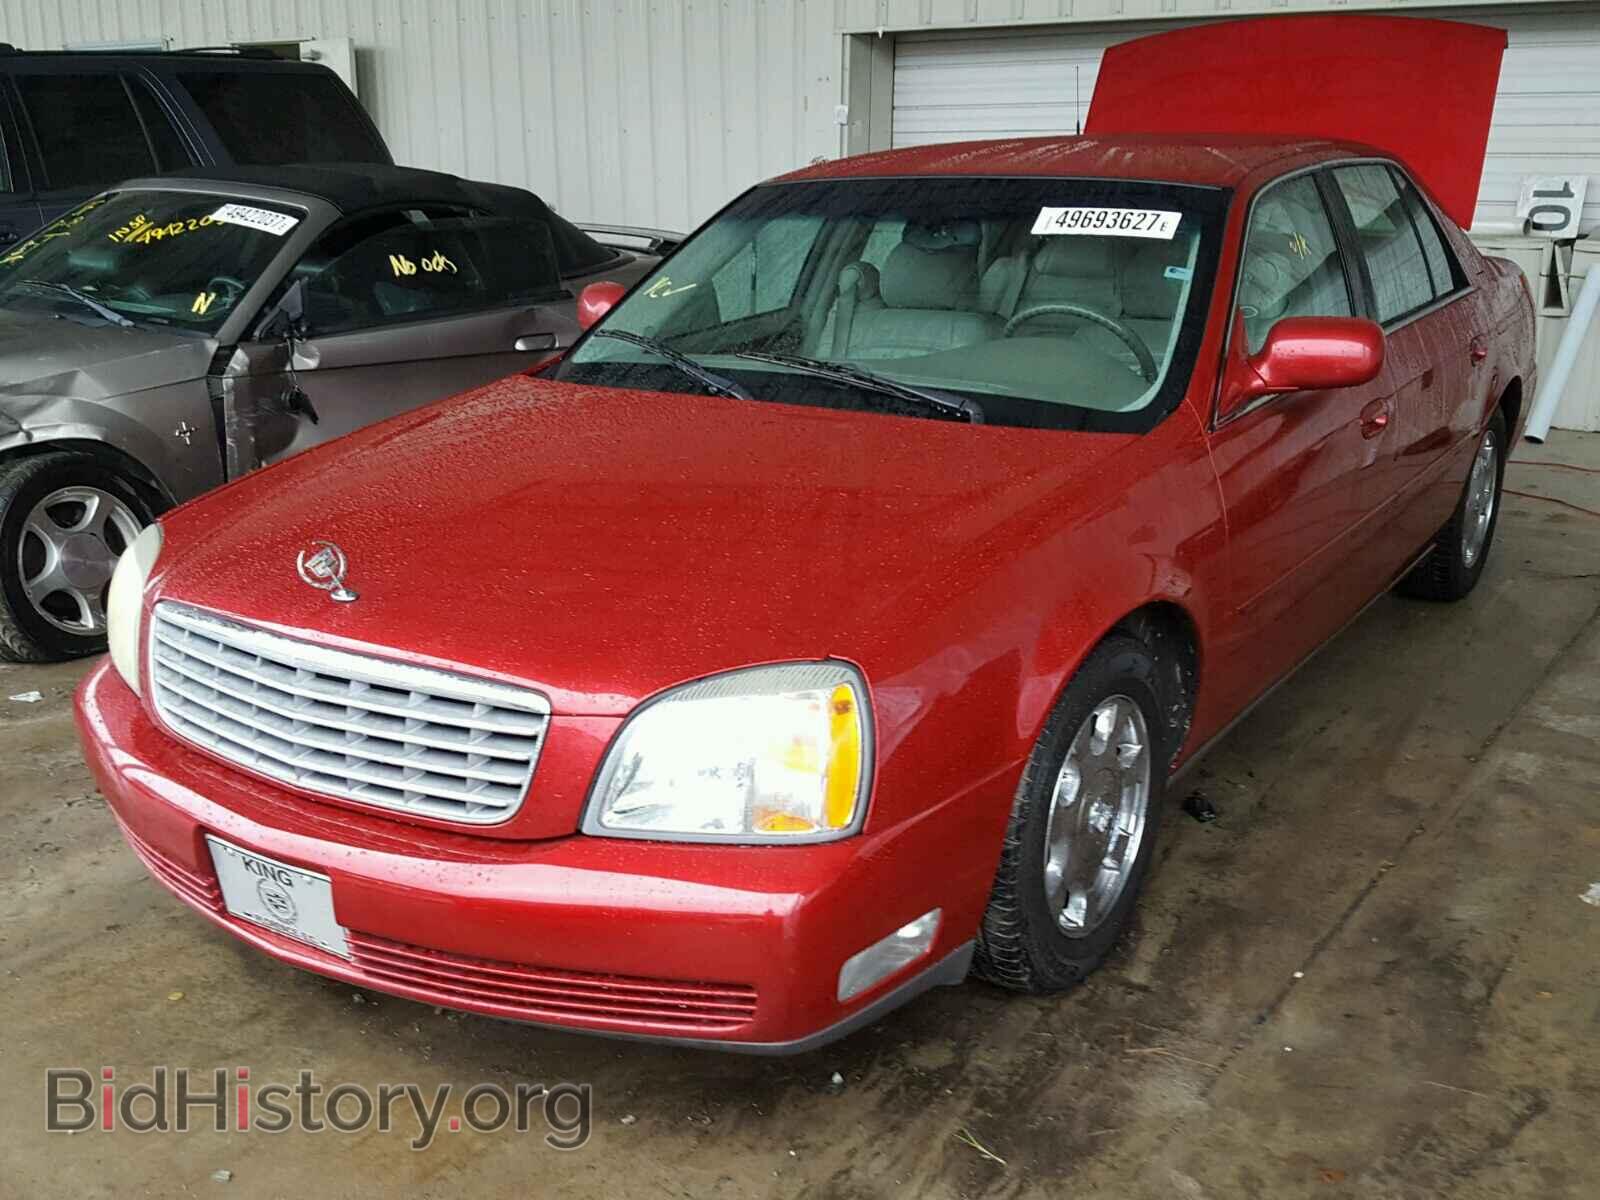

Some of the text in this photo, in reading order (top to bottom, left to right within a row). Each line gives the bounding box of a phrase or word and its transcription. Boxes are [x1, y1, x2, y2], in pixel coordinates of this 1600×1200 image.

[1528, 181, 1575, 231] 10
[1055, 209, 1161, 232] 49693627
[191, 292, 215, 315] N
[241, 855, 294, 887] KING
